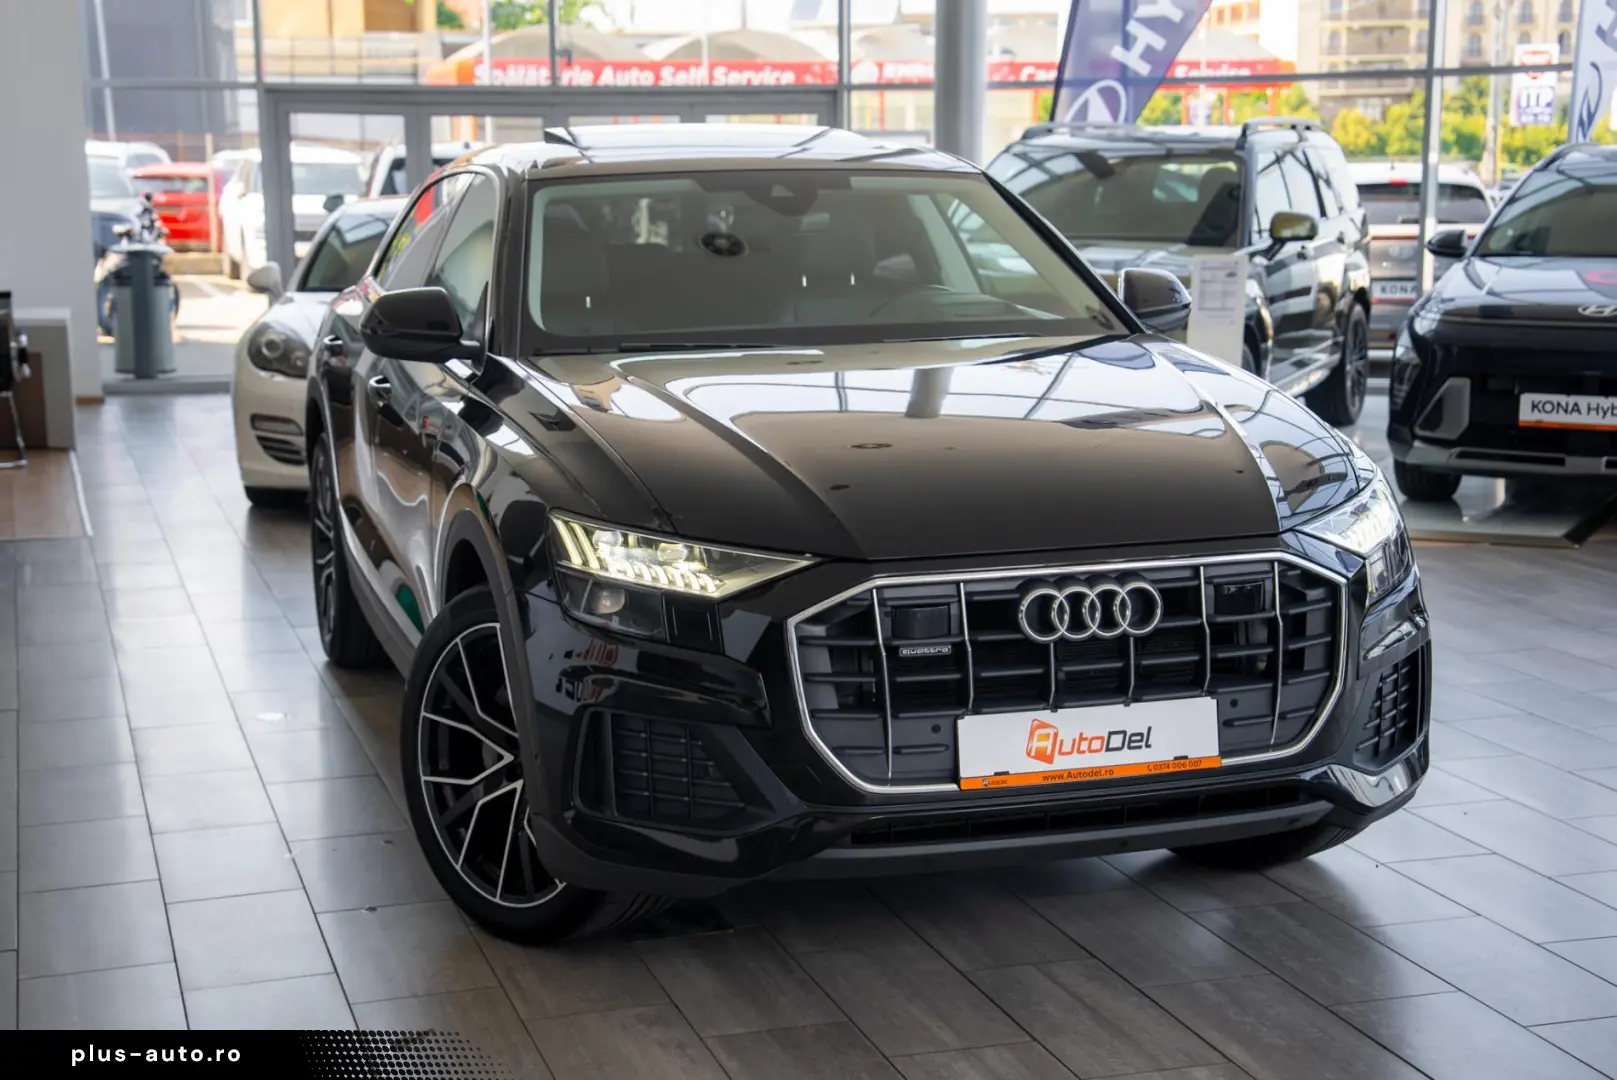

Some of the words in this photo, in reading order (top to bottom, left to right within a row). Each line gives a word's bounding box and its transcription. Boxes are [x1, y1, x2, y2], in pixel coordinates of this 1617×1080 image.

[598, 65, 655, 86] Auto
[712, 65, 796, 86] Service
[1531, 399, 1582, 415] KONA
[902, 646, 949, 656] quattro
[1027, 721, 1152, 760] AutoDel
[1042, 769, 1115, 782] www.Autodel.ro
